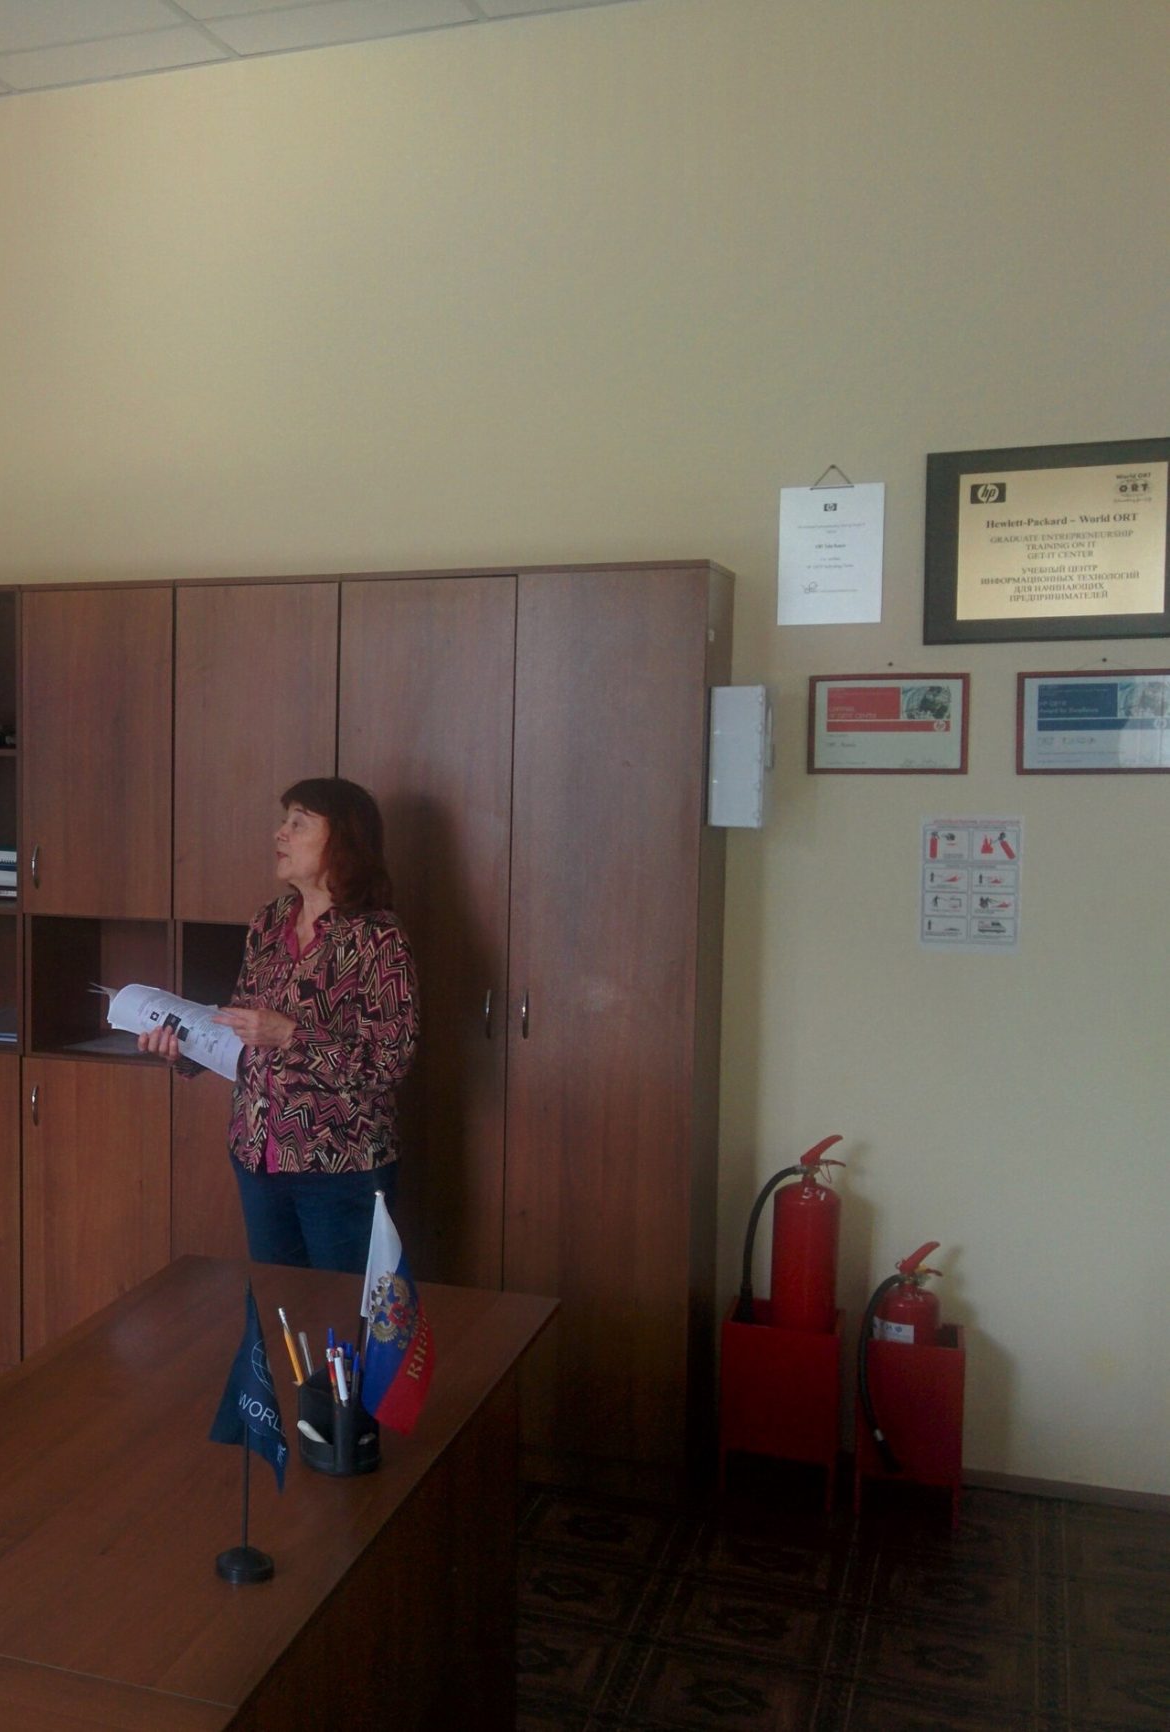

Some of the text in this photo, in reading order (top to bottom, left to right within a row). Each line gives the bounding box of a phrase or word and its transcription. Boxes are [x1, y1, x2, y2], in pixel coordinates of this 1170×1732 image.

[1119, 483, 1148, 492] ORT
[986, 516, 1067, 529] Hewlett-Packard
[1079, 513, 1110, 524] World
[1113, 512, 1138, 522] ORT
[990, 530, 1134, 544] GRADUATE ENTREPRENEURSHIP
[1026, 542, 1070, 550] TRAINING
[1071, 541, 1085, 549] ON
[1056, 550, 1094, 559] CENTER
[1021, 563, 1098, 575] УЧЕБНЫЙ ЦЕНТР
[1077, 570, 1140, 581] ТЕХНОЛОГИЙ
[1014, 582, 1105, 594] ДЛЯ НАЧИНАЮЩИХ
[1009, 590, 1108, 602] ПРЕДПРИНИМАТЕЛЕЙ
